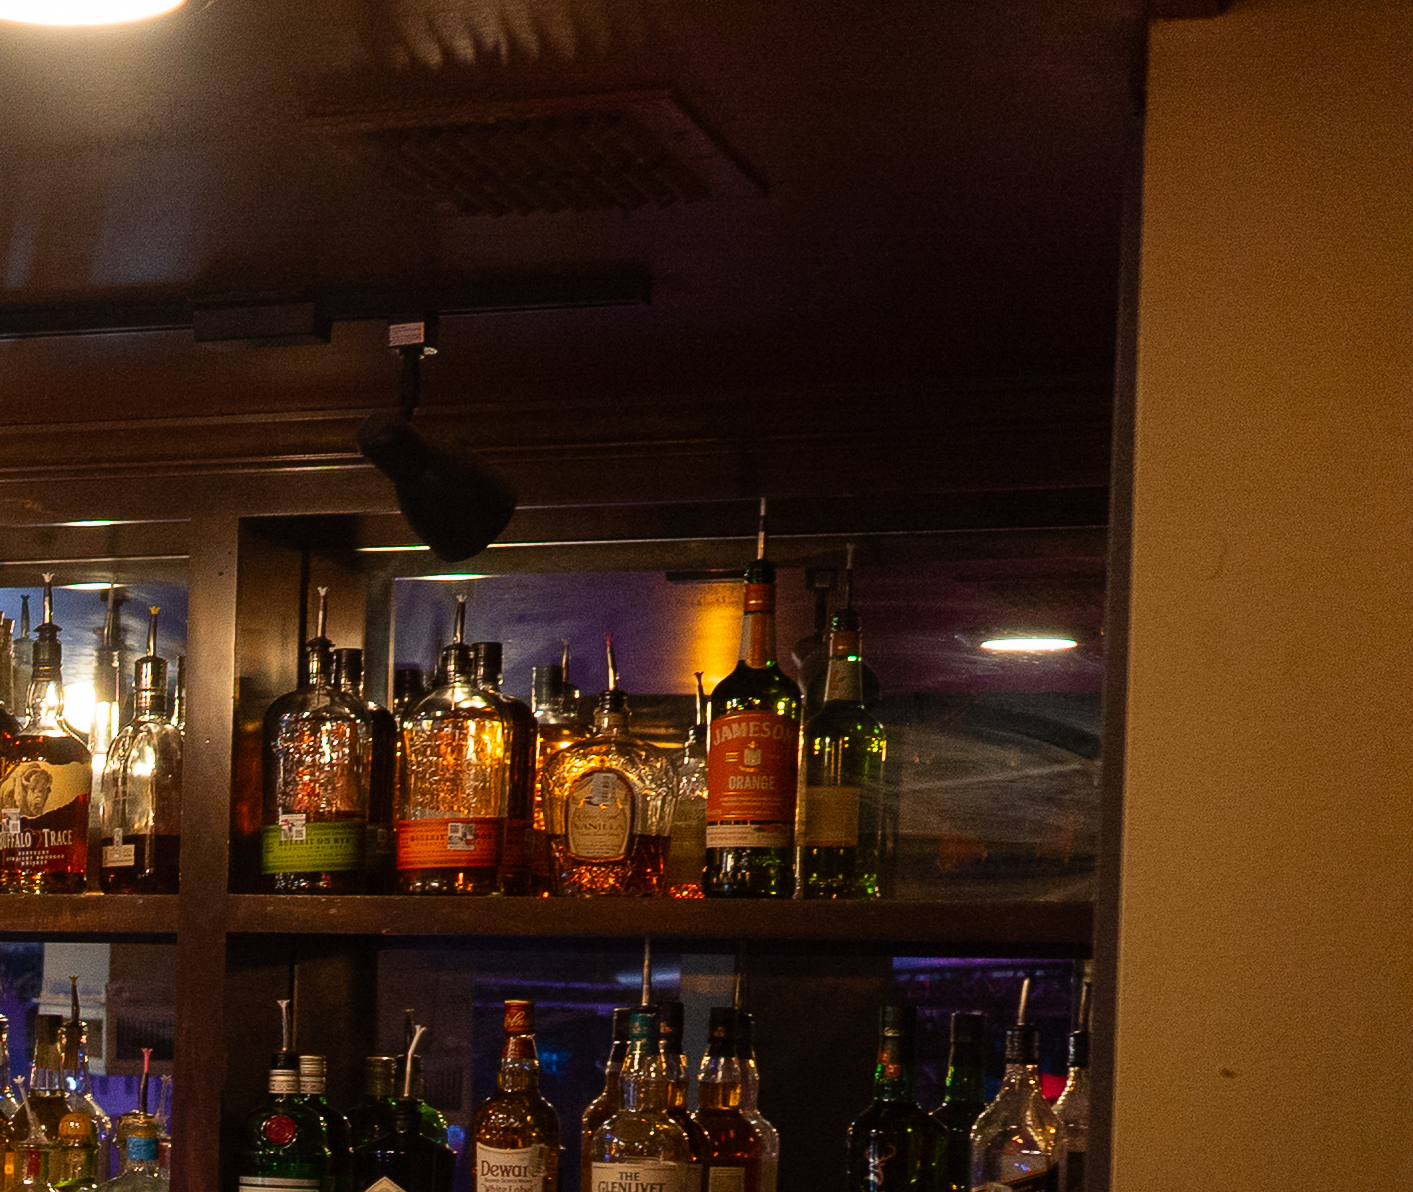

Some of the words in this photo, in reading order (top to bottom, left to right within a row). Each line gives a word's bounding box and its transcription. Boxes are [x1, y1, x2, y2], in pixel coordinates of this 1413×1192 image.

[728, 775, 776, 790] ORANGE
[42, 828, 73, 848] TRACE
[618, 1171, 641, 1181] THE
